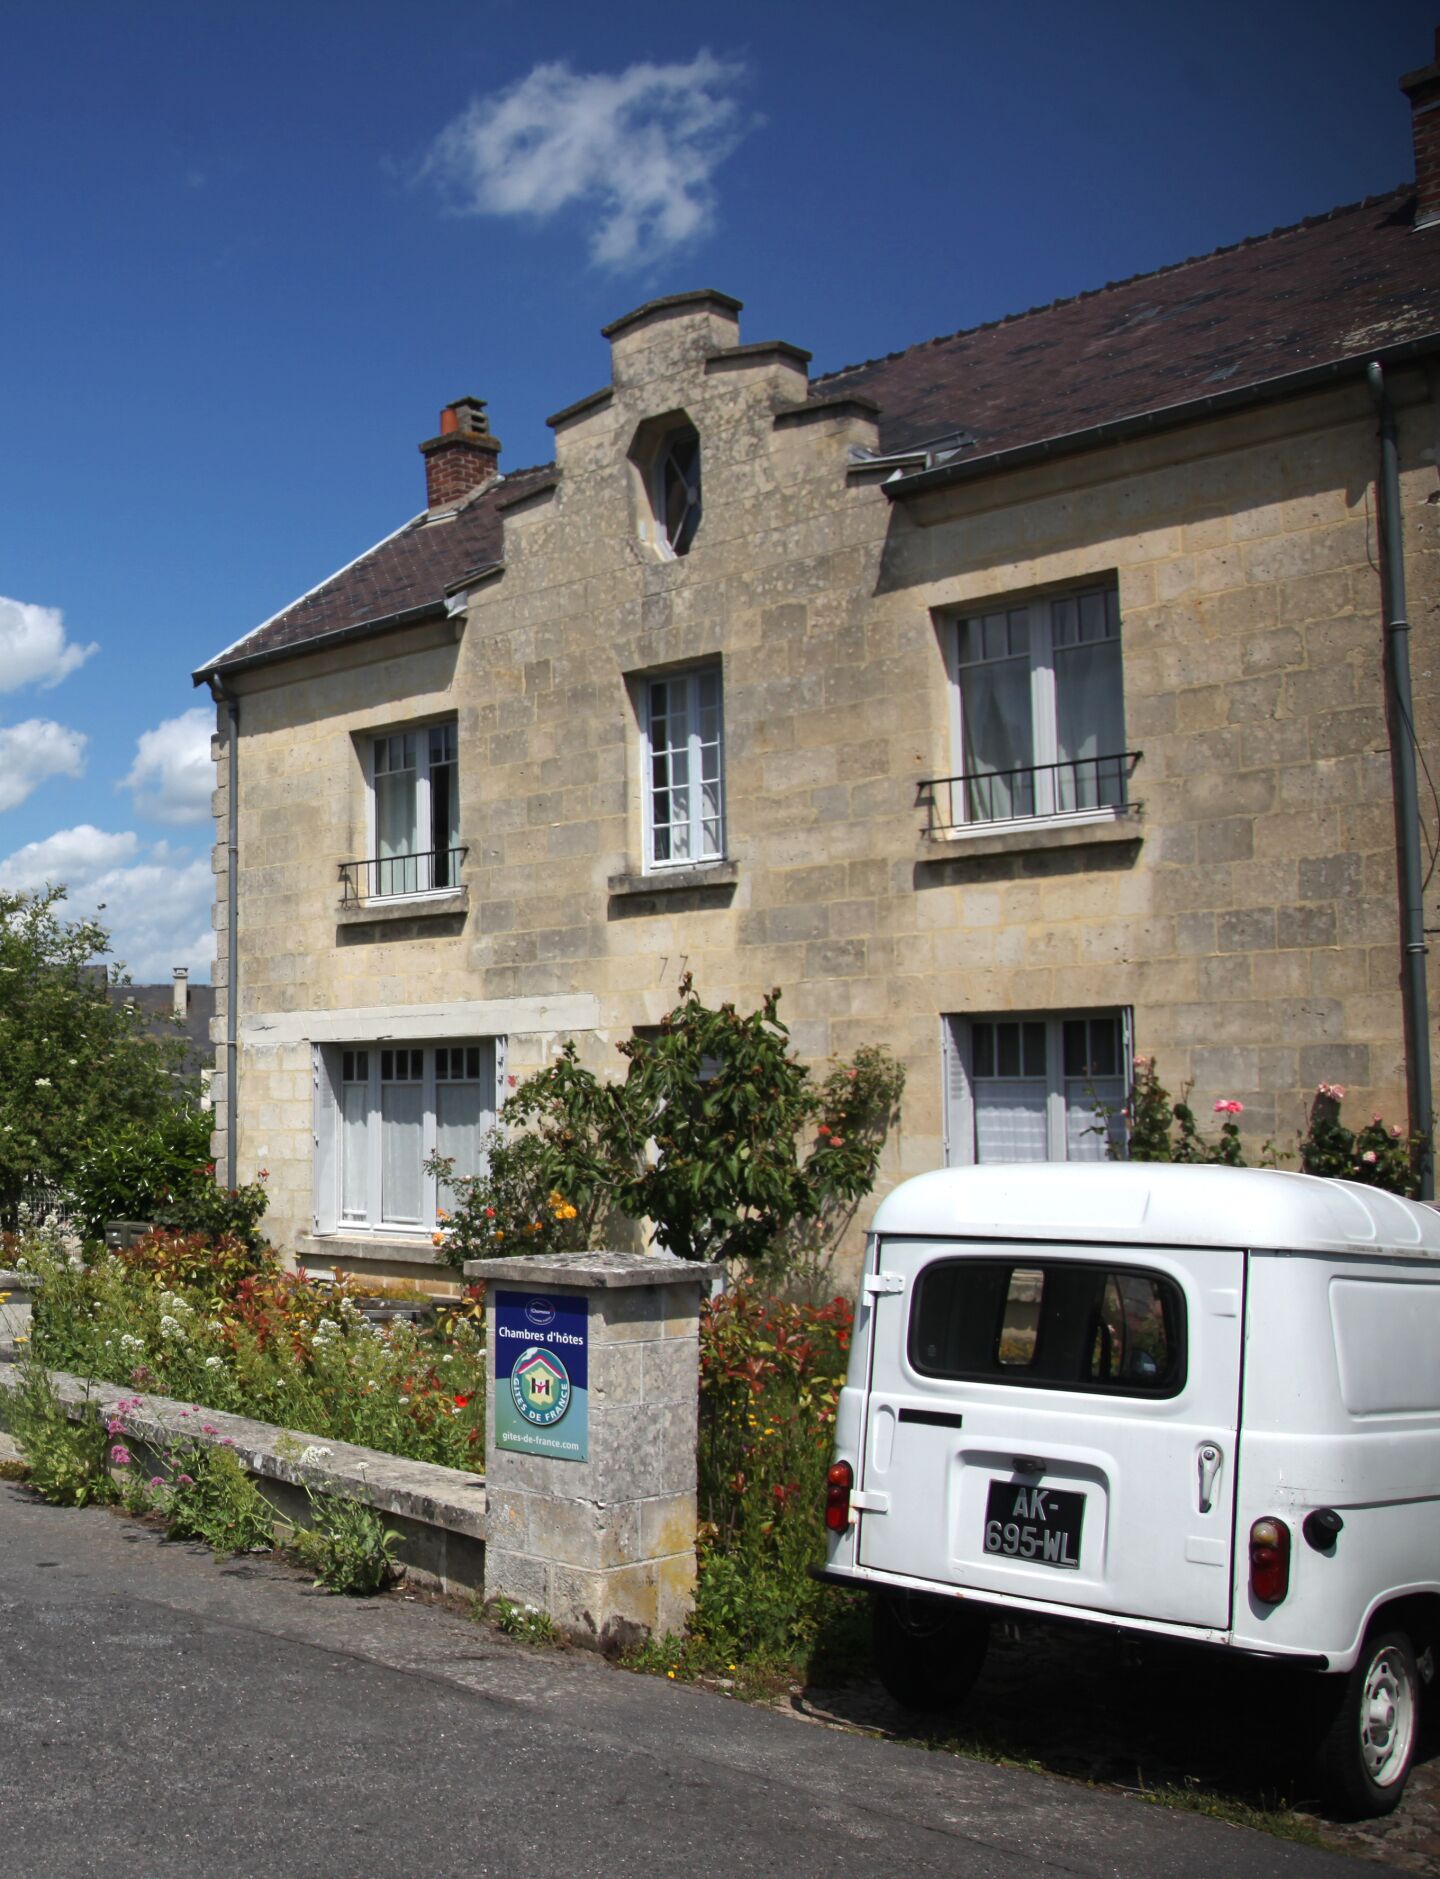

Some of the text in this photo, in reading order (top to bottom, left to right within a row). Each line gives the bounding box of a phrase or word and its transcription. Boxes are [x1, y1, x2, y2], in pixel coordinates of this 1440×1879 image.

[498, 1326, 584, 1345] Chambres d'hôtes
[529, 1410, 542, 1422] DE
[545, 1383, 568, 1422] FRANCE
[985, 1520, 1078, 1565] 695-WL
